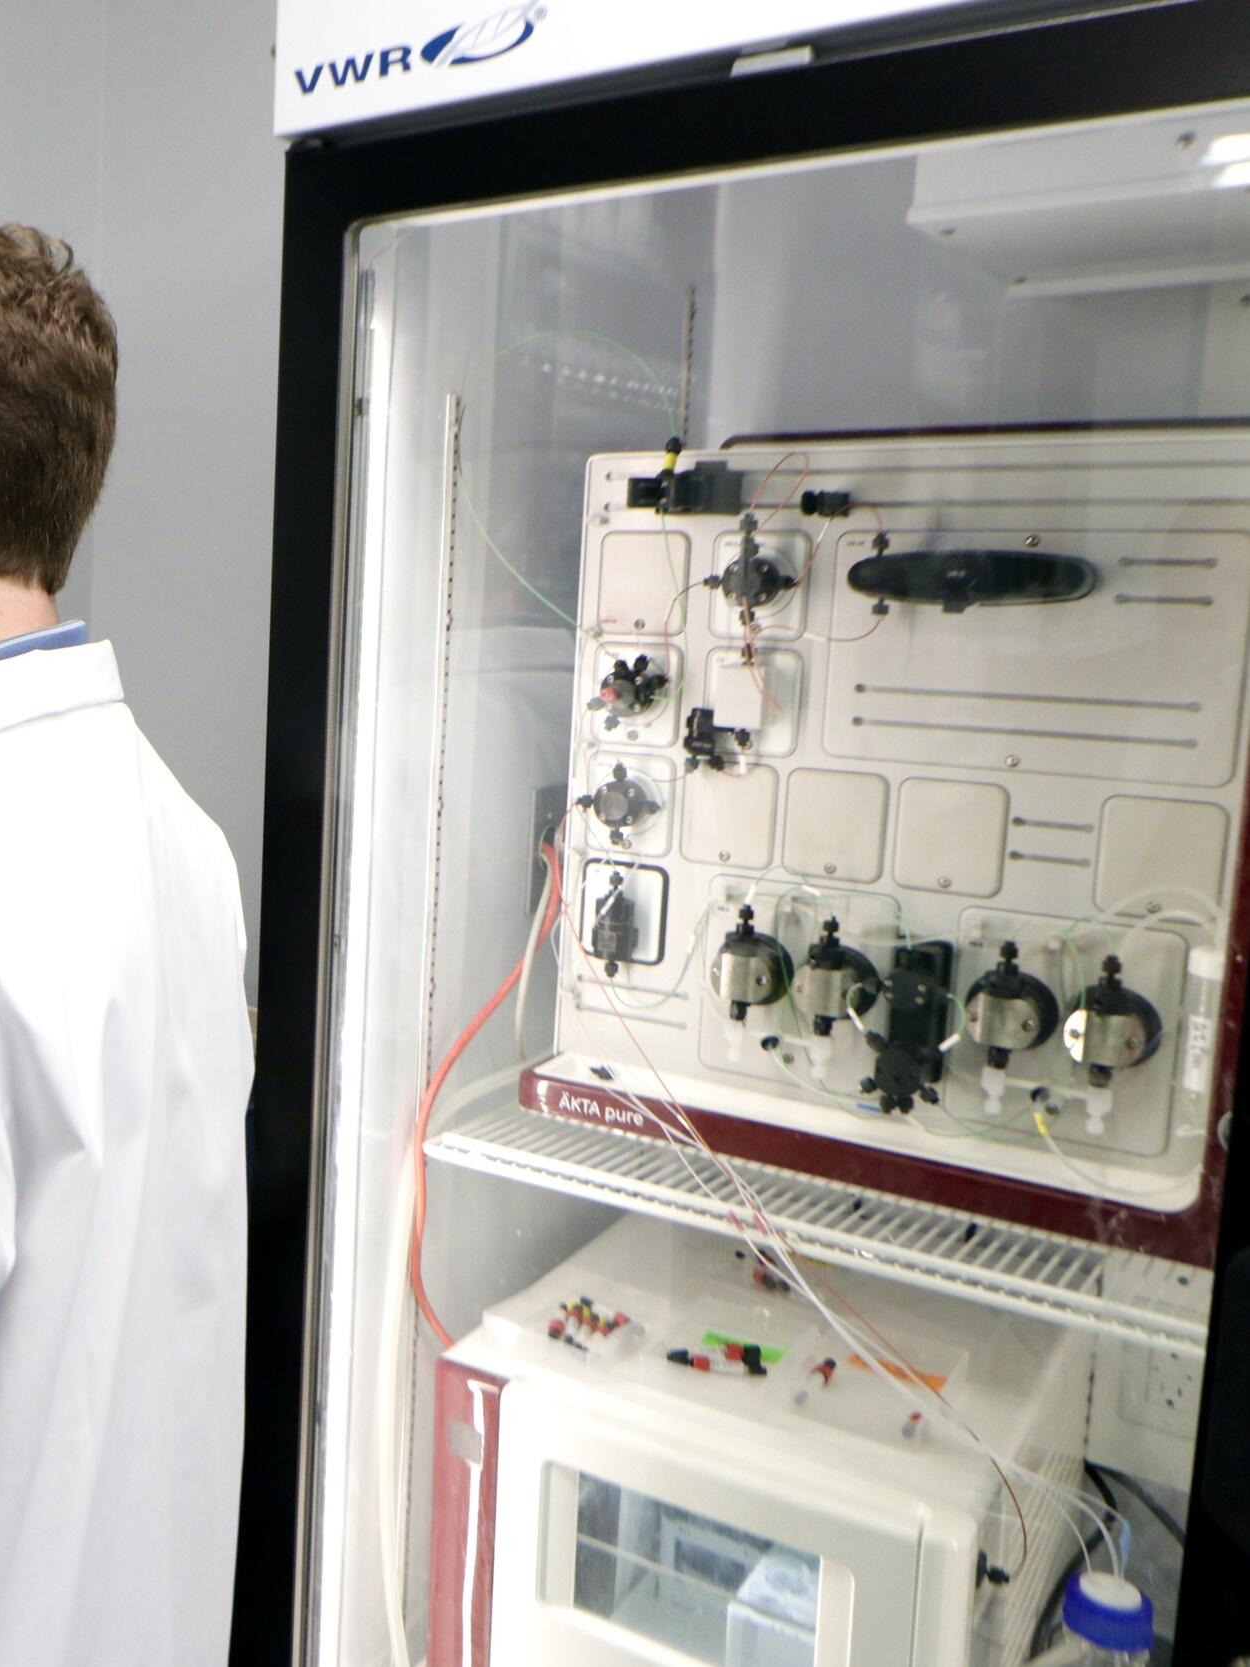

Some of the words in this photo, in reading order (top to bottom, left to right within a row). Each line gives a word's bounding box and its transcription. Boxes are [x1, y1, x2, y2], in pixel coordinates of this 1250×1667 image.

[294, 45, 412, 95] VWR
[558, 1090, 601, 1119] ÄKTA
[604, 1106, 644, 1127] pure
